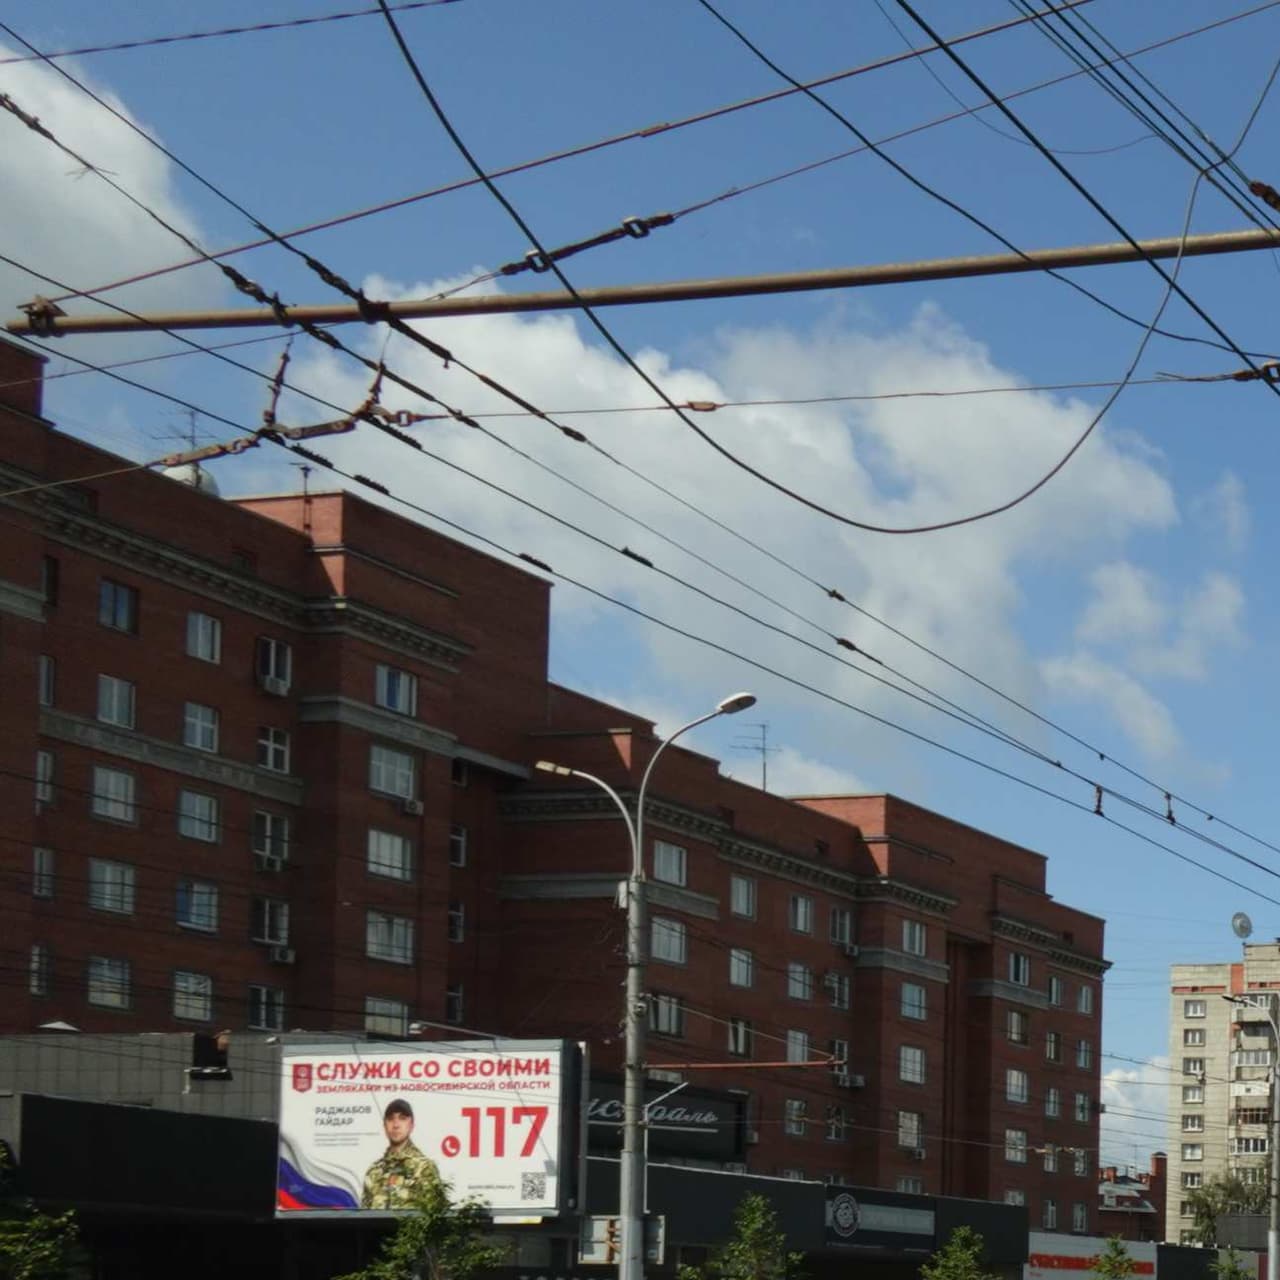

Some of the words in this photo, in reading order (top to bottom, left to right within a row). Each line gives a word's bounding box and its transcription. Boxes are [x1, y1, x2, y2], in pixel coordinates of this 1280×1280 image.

[316, 1061, 401, 1081] СЛУЖИ
[409, 1060, 440, 1078] СО
[447, 1058, 551, 1077] СВОИМИ
[316, 1083, 382, 1094] ЗЕМЛЯКАМИ
[384, 1083, 398, 1092] ИЗ
[400, 1080, 495, 1092] НОВОСИБИРСКОЙ
[498, 1080, 551, 1090] ОБЛАСТИ
[315, 1105, 372, 1115] РАДЖАБОВ
[315, 1116, 354, 1127] ГАЙДАР
[461, 1106, 549, 1158] 117
